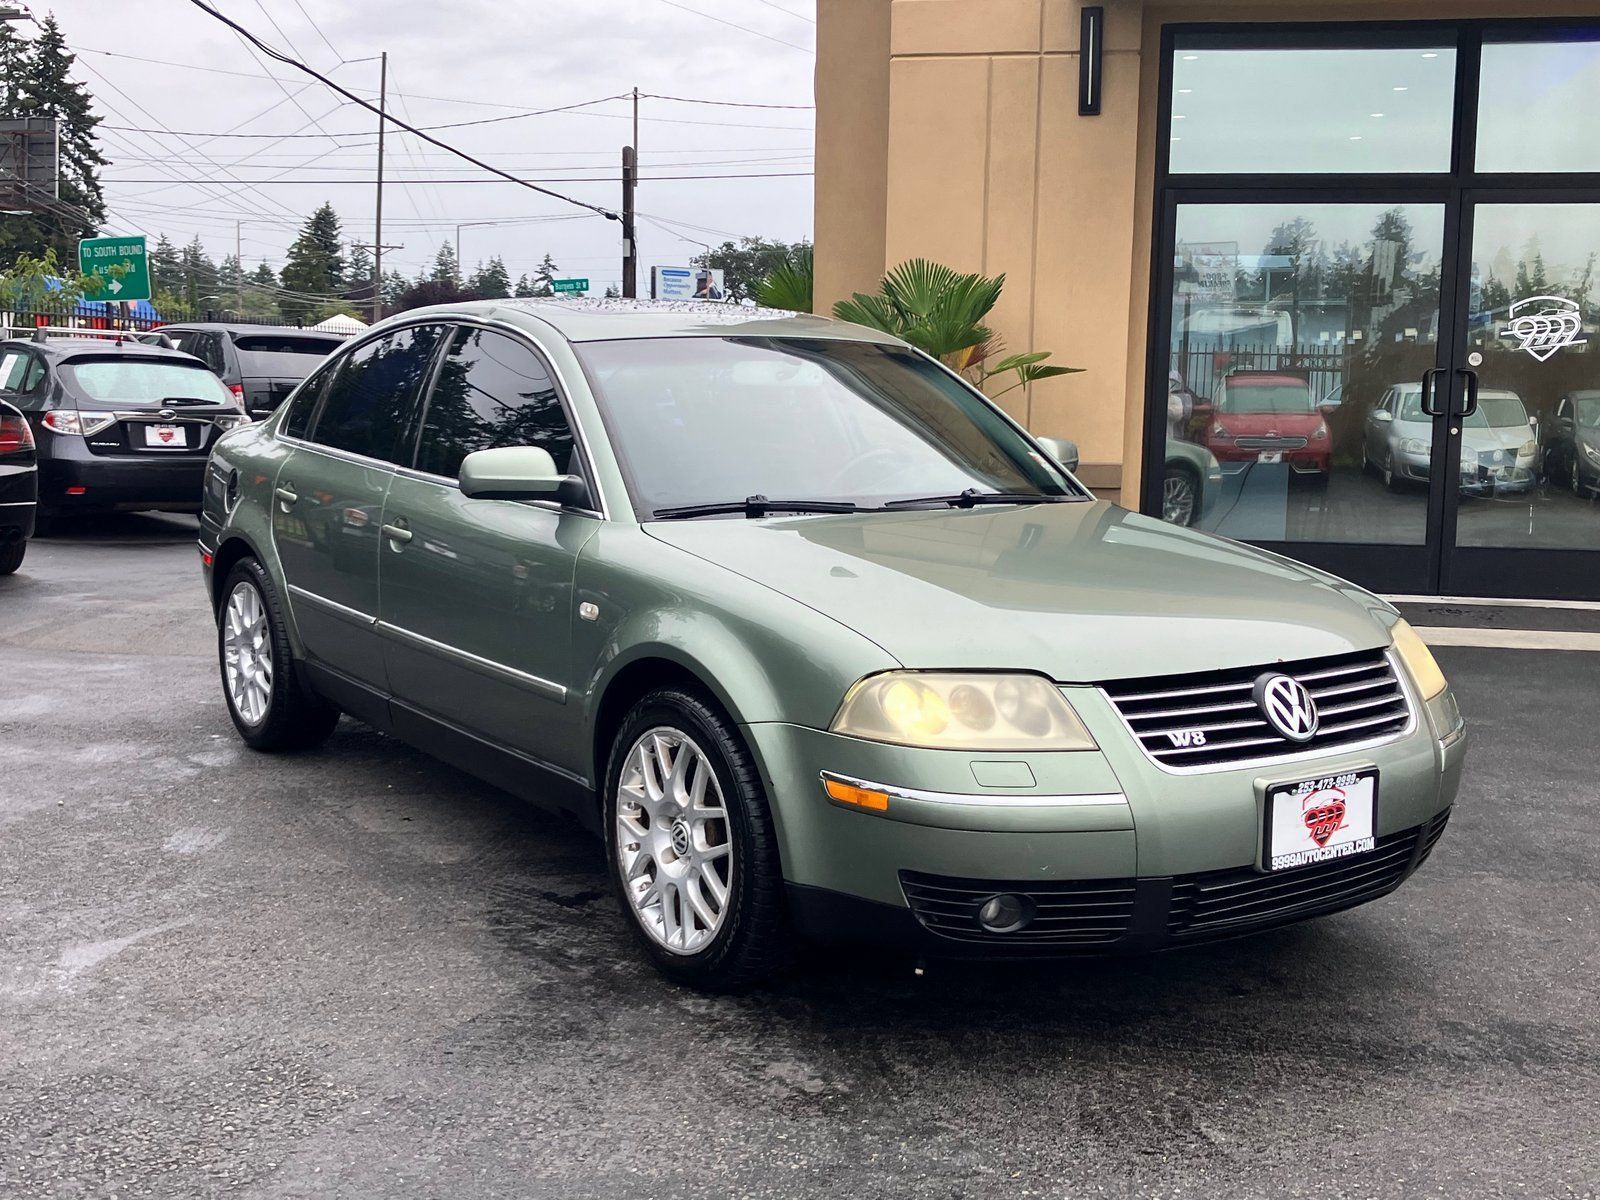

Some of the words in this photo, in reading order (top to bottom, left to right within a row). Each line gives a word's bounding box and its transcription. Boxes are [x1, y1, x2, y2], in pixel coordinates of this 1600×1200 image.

[82, 247, 92, 257] TO
[94, 246, 117, 257] SOUTH
[119, 244, 143, 256] BOUND
[1166, 730, 1207, 747] W8
[1297, 773, 1357, 794] 253-473-9999
[1271, 836, 1375, 870] 9999AUTOCENTER.COM
